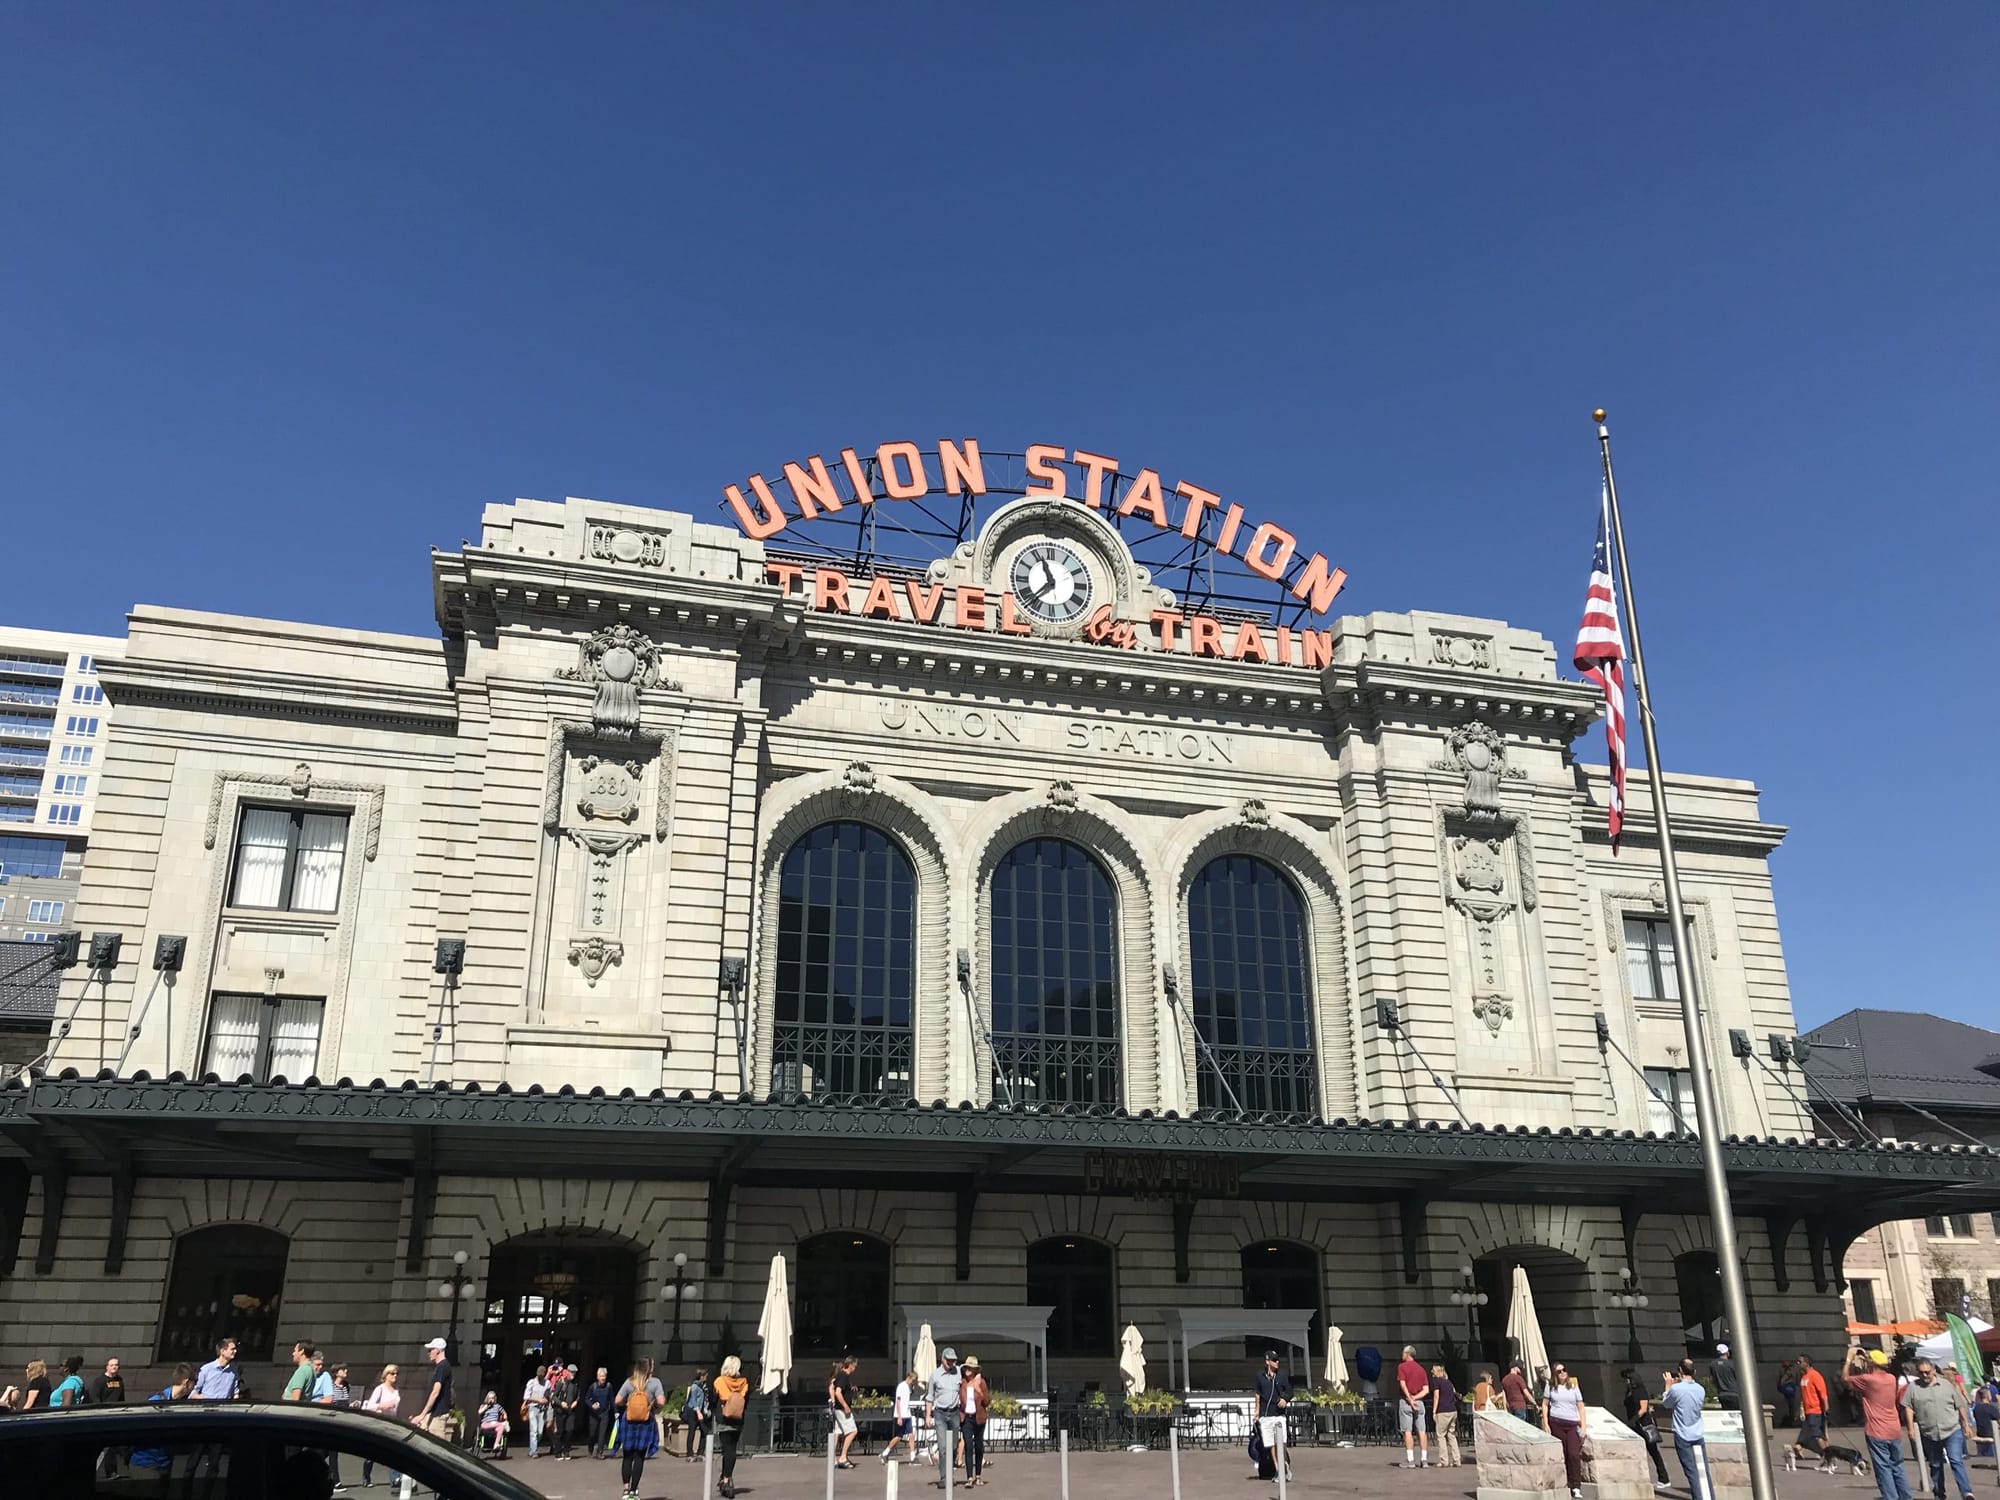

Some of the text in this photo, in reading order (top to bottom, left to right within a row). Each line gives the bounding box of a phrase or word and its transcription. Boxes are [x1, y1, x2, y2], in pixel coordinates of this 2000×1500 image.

[723, 438, 1348, 616] UNION STATION
[766, 561, 1031, 635] TRAVEL
[1150, 608, 1333, 669] TRAIN
[879, 701, 1233, 764] UNION STATION
[589, 776, 627, 797] 1880
[1464, 853, 1495, 872] 1914
